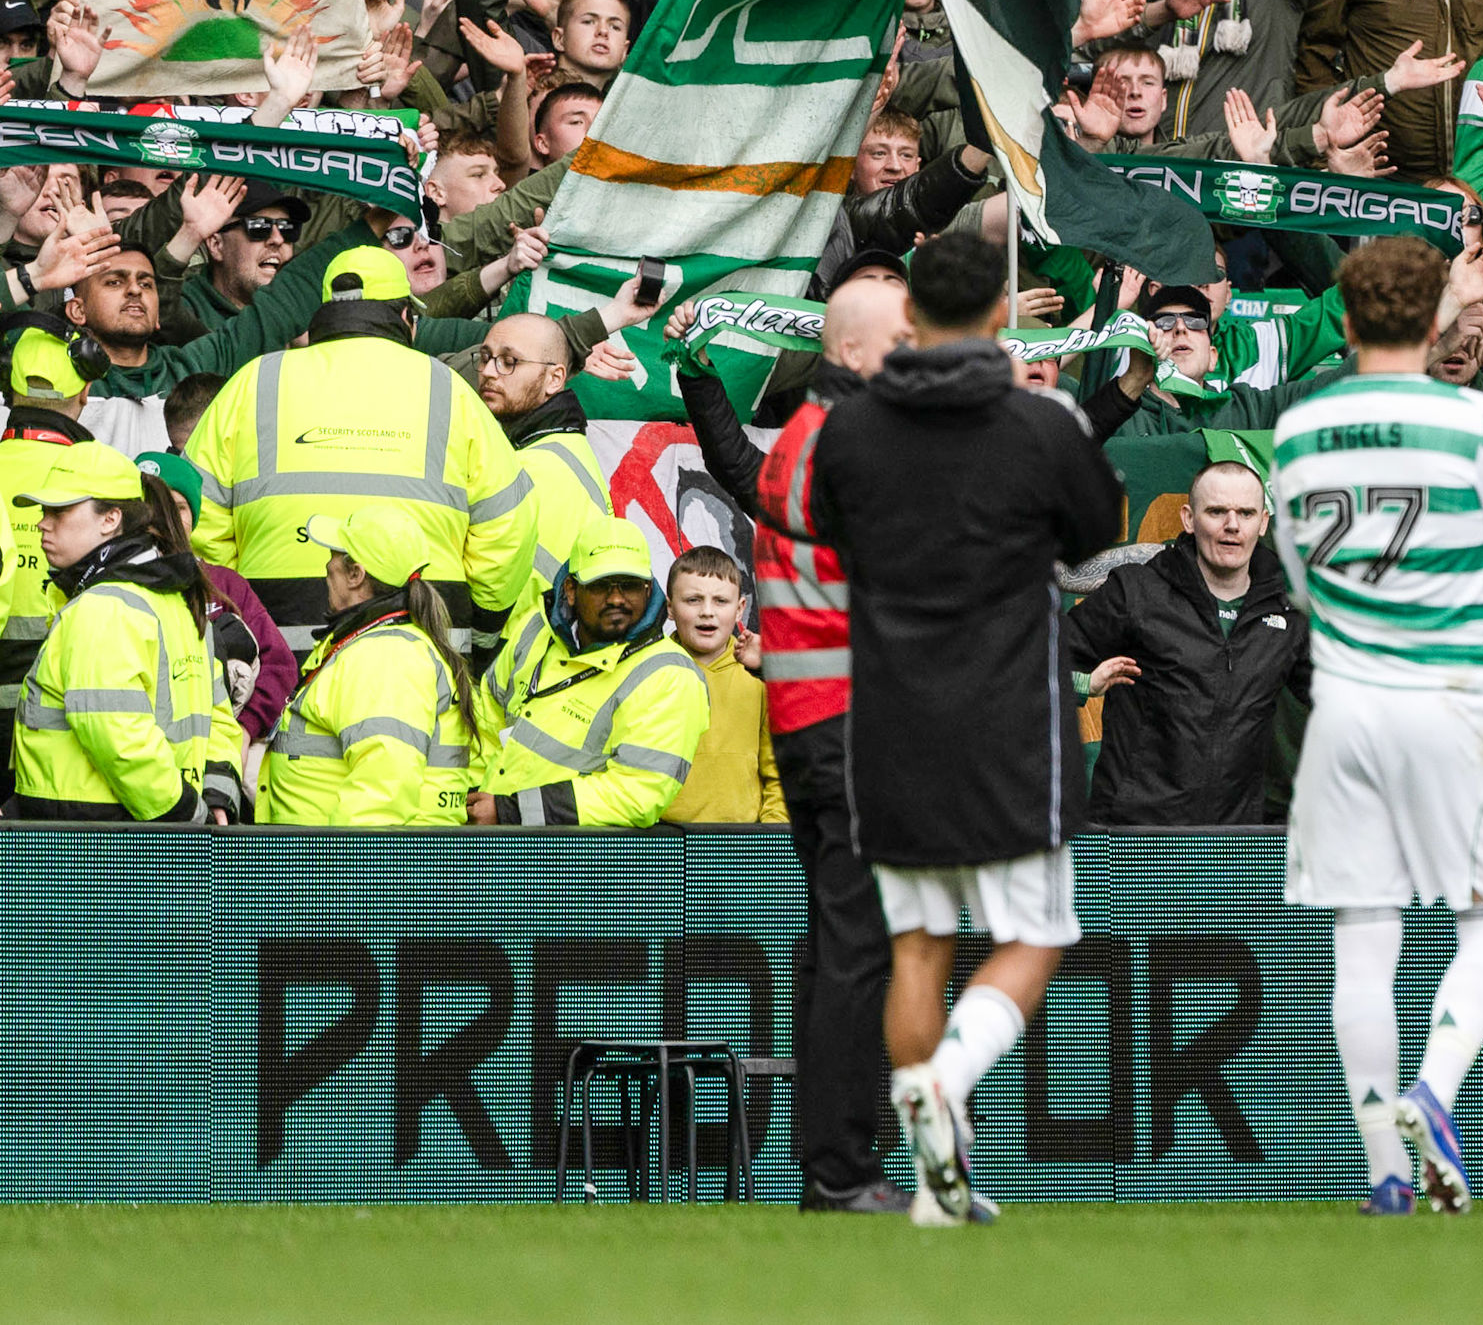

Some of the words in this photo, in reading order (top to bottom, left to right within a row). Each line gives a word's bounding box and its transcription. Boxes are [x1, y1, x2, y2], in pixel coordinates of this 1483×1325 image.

[0, 122, 119, 151] EEN
[211, 139, 417, 203] BRIGADE
[693, 296, 826, 341] Glas
[1318, 426, 1403, 452] ENGELS
[1303, 487, 1429, 585] 27
